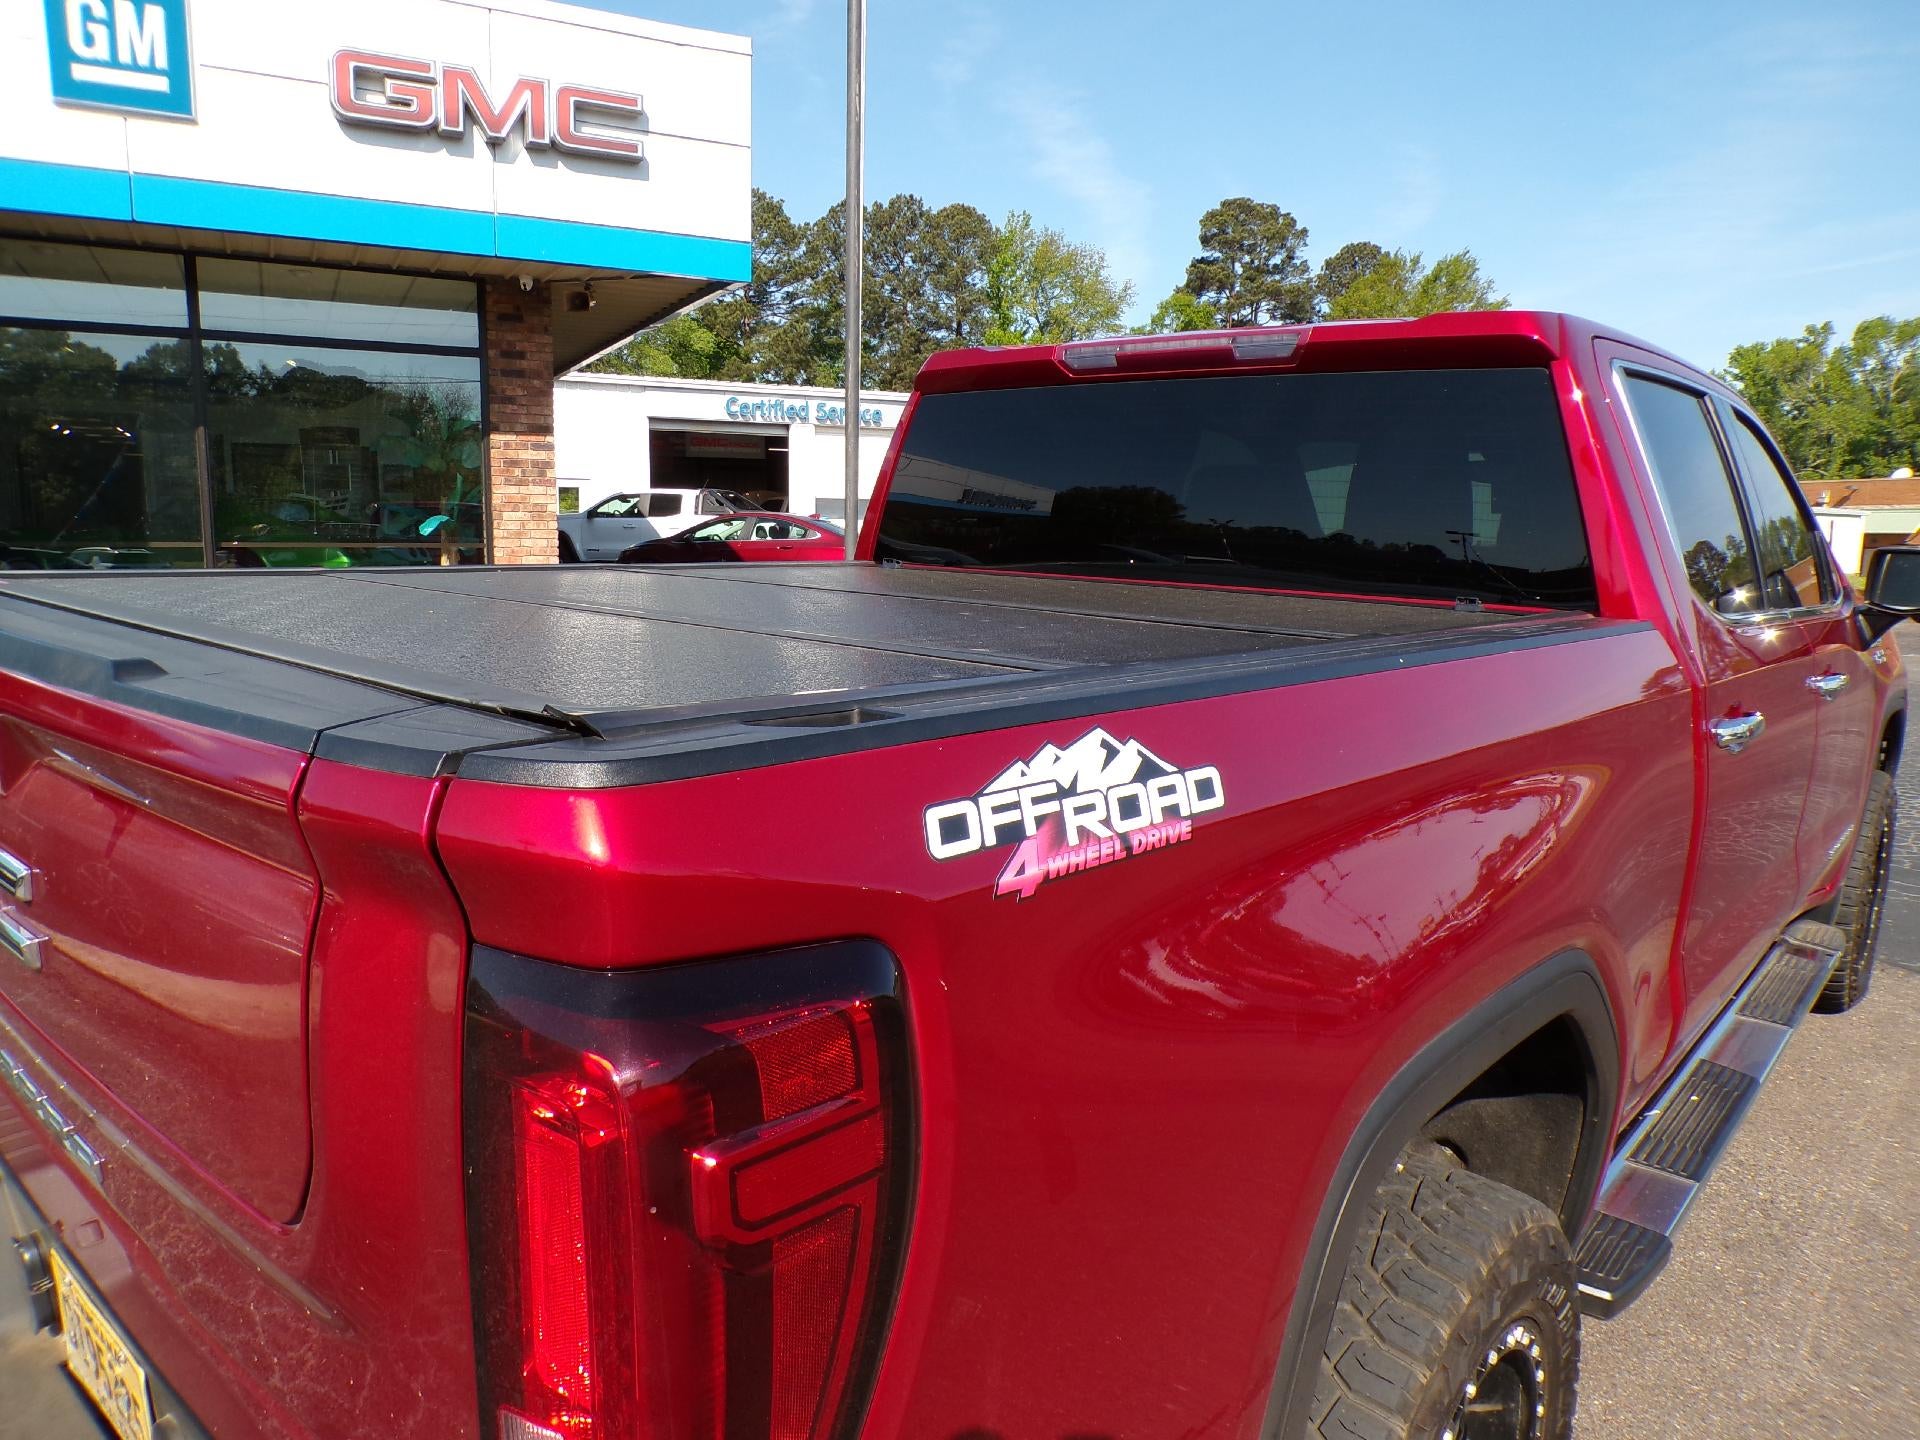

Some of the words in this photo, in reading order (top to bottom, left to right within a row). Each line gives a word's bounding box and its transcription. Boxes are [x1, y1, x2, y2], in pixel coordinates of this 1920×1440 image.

[65, 0, 169, 71] GM
[329, 47, 644, 163] GMC
[726, 396, 809, 418] Certified
[815, 402, 883, 423] Serce
[995, 837, 1045, 901] 4
[1046, 838, 1128, 880] WHEEL
[1132, 819, 1193, 855] DRIVE
